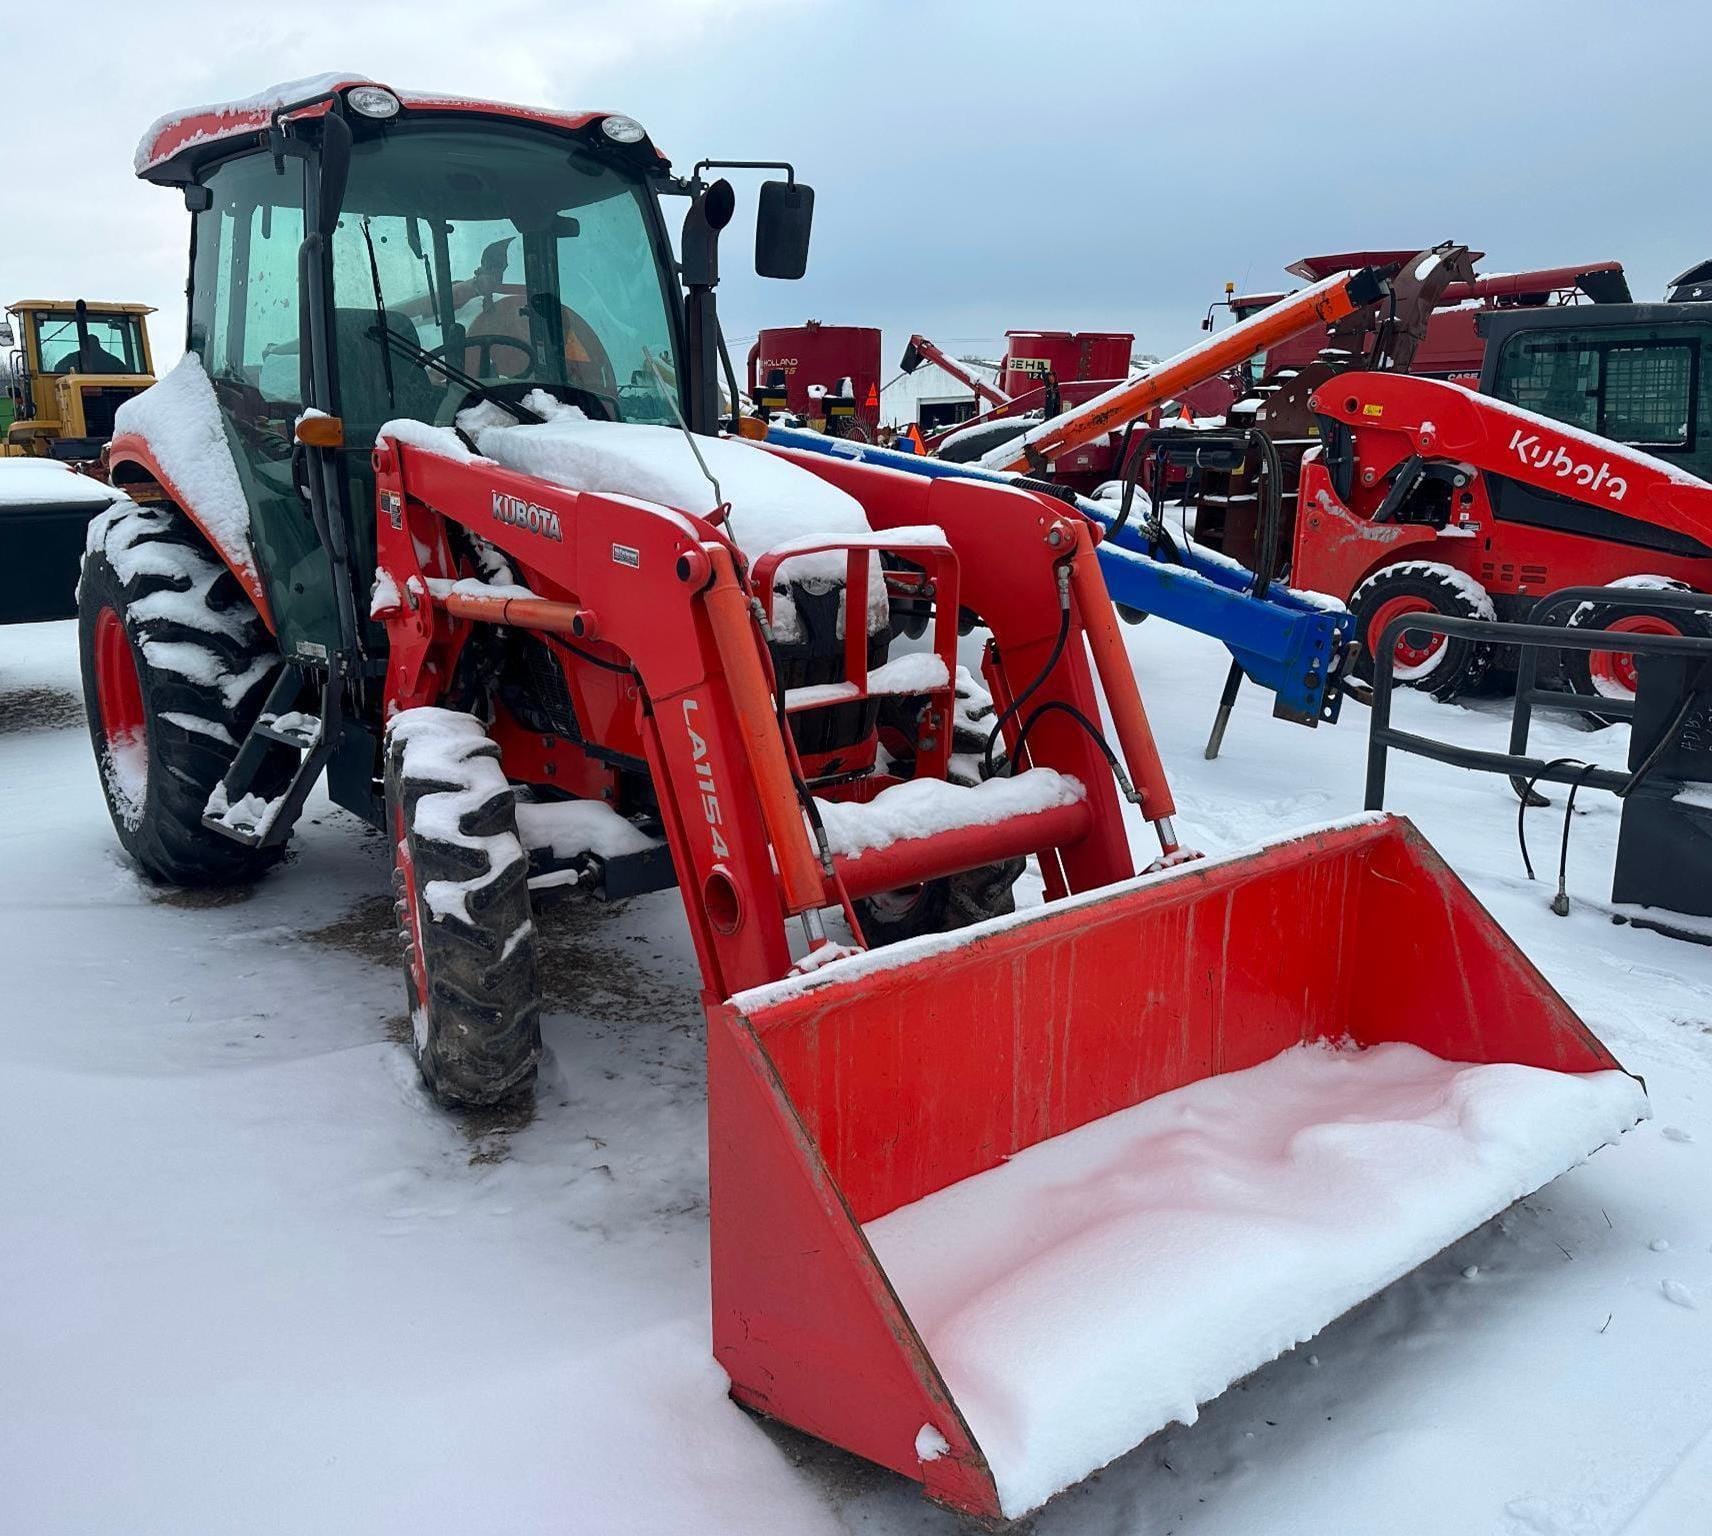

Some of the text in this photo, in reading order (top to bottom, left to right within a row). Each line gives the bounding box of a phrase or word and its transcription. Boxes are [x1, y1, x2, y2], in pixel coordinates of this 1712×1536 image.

[763, 358, 798, 367] HOLLAND
[1010, 359, 1048, 370] GEHL
[1447, 372, 1479, 381] CASE
[1508, 429, 1628, 501] Kubota
[491, 491, 563, 543] KUBOTA
[682, 698, 730, 860] LA1154
